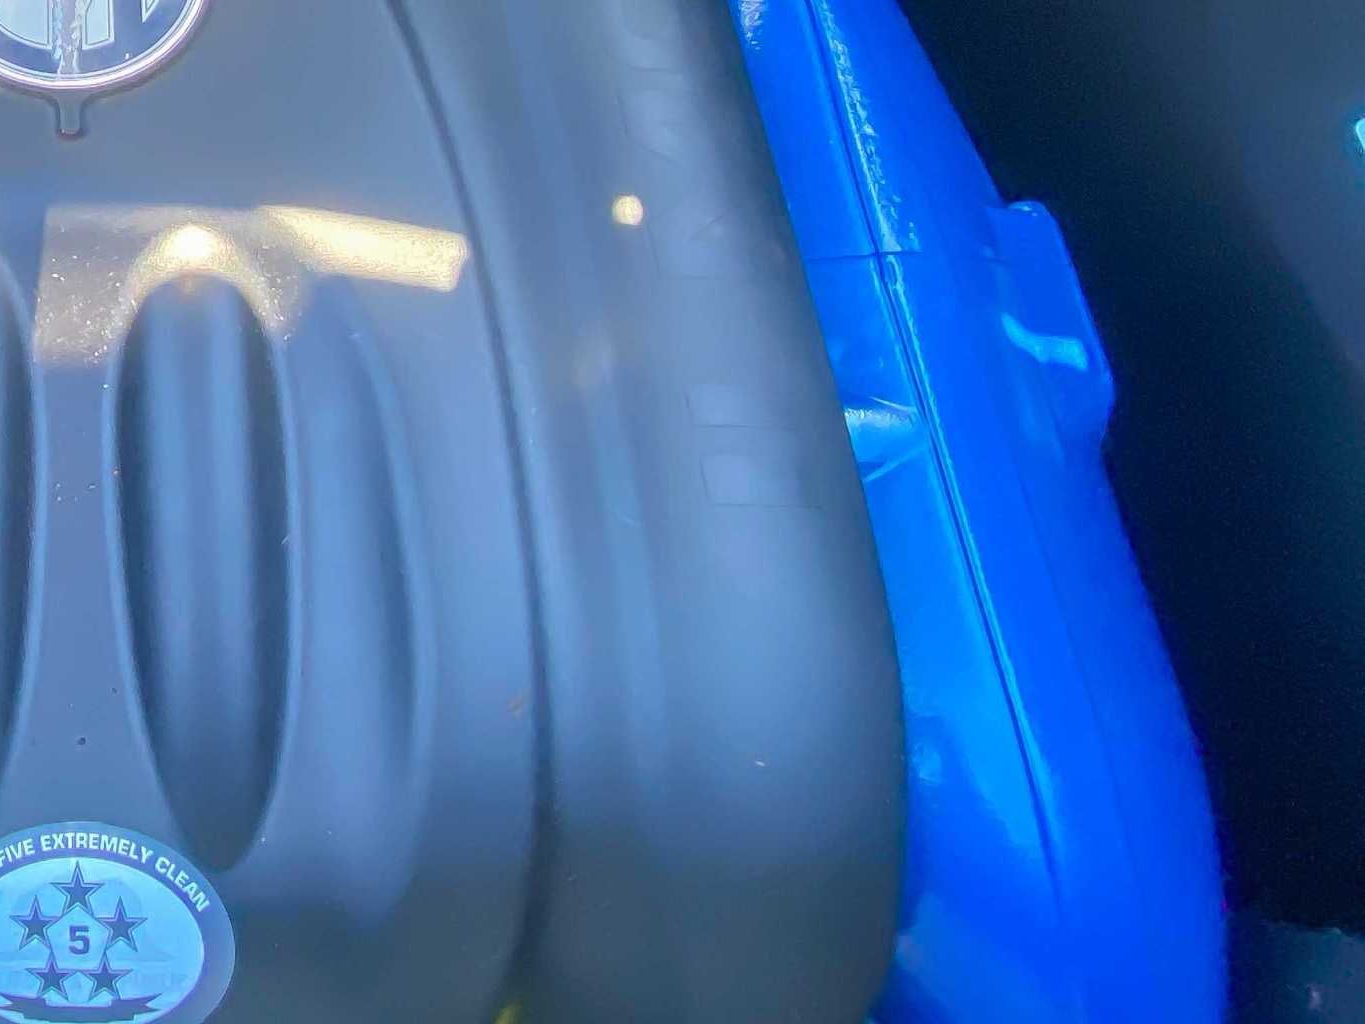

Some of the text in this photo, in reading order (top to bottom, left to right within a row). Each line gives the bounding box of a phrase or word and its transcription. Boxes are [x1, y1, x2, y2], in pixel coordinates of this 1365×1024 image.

[40, 832, 154, 864] EXTREMELY
[154, 856, 210, 913] CLEAN
[68, 925, 91, 955] 5
